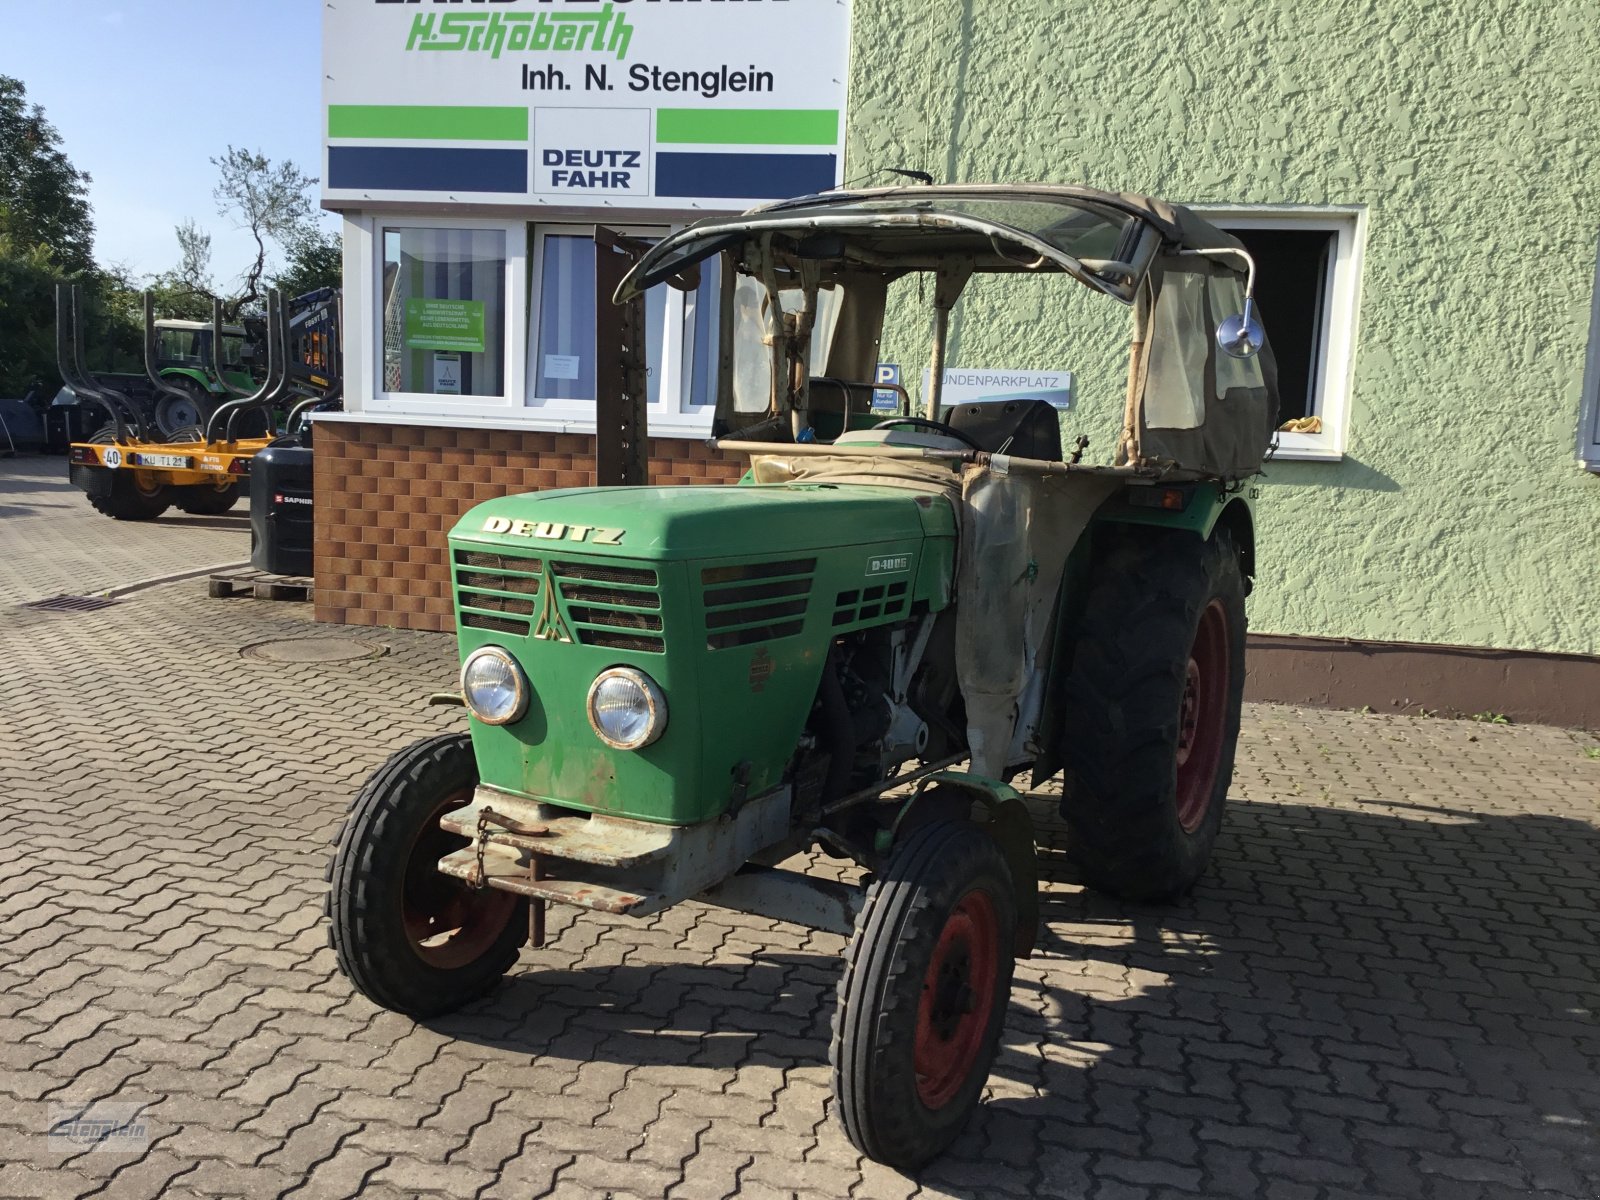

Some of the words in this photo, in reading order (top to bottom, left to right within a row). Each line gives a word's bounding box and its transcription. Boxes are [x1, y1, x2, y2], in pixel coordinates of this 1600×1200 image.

[522, 63, 571, 90] Inh.
[585, 64, 614, 91] N.
[628, 63, 773, 98] Stenglein
[543, 149, 641, 168] DEUTZ
[552, 170, 631, 188] FAHR
[878, 366, 894, 384] P
[941, 374, 1059, 388] UNDENPARKPLATZ
[106, 450, 119, 465] 40
[284, 496, 313, 505] SAPHIR
[482, 516, 626, 545] DEUTZ
